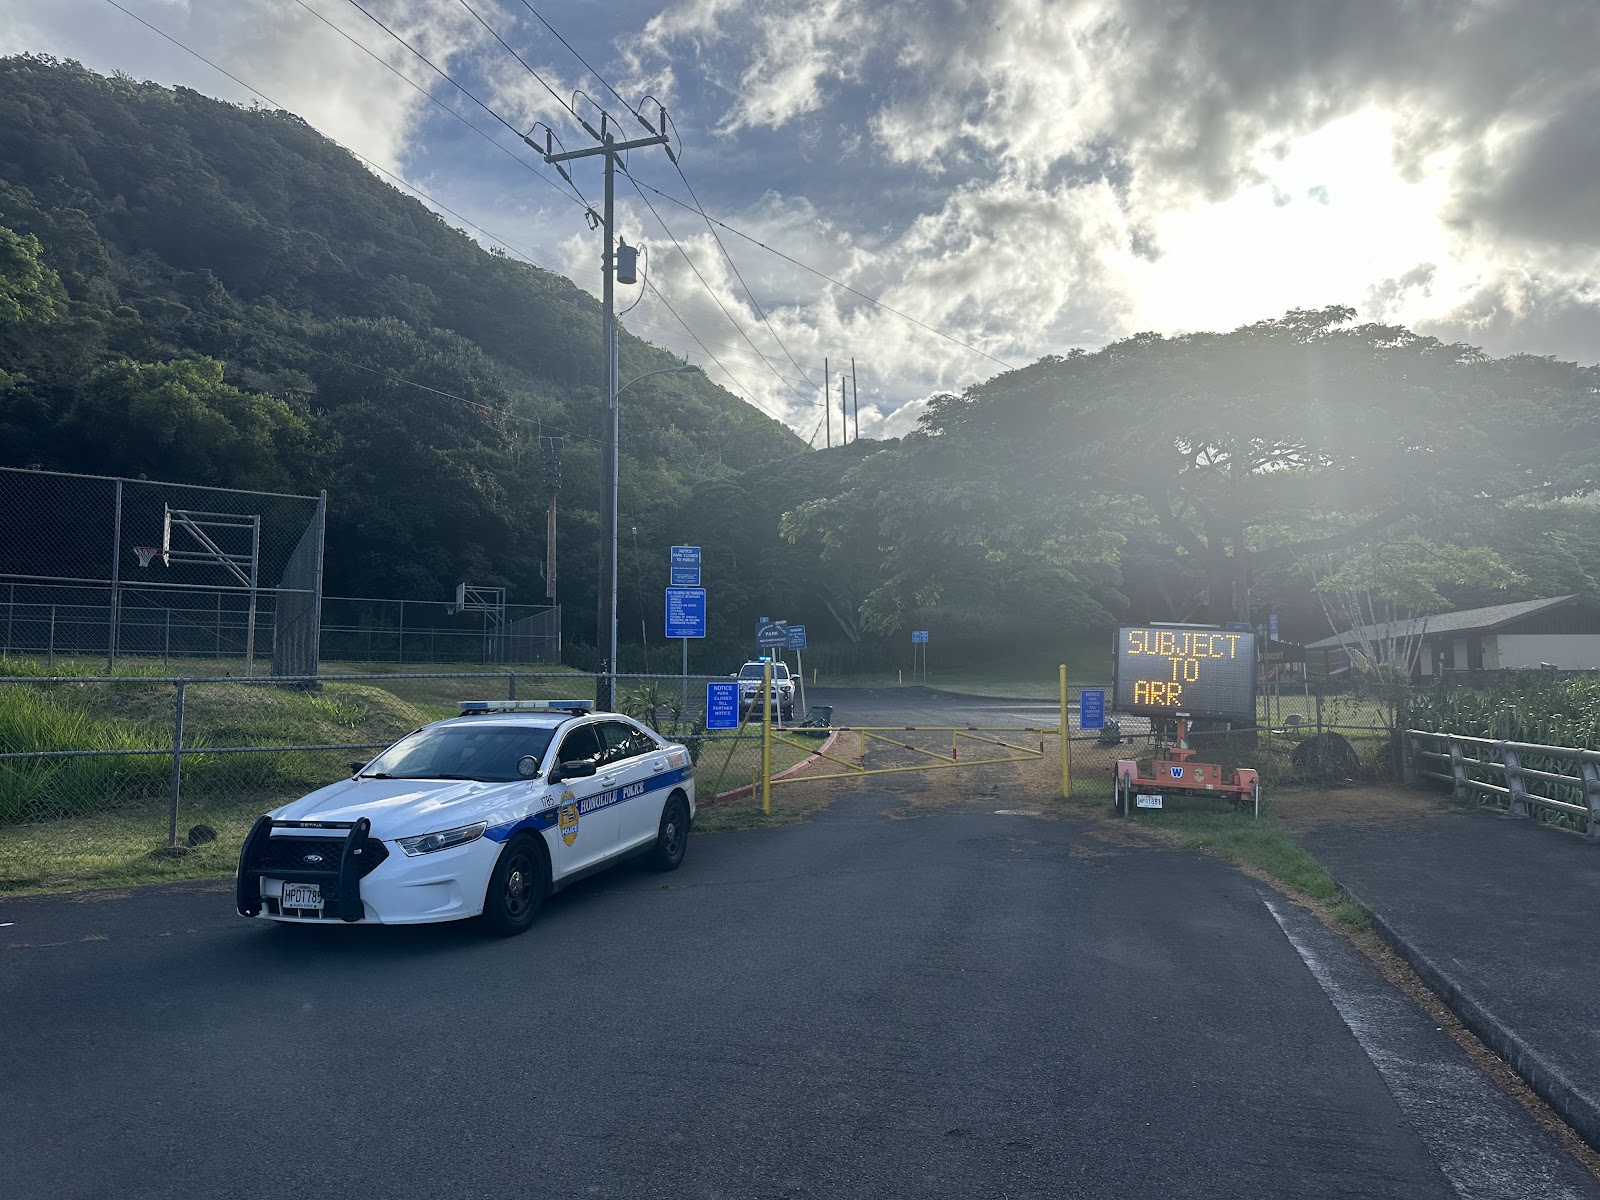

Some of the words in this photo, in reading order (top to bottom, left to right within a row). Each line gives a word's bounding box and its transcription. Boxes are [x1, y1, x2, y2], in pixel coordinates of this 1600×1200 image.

[1128, 630, 1240, 658] SUBJECT
[1168, 657, 1199, 682] TO
[1134, 680, 1182, 707] ARR
[1171, 768, 1182, 777] W
[580, 790, 618, 813] HONOLULU
[622, 782, 645, 799] POLICE
[562, 825, 579, 836] POLICE
